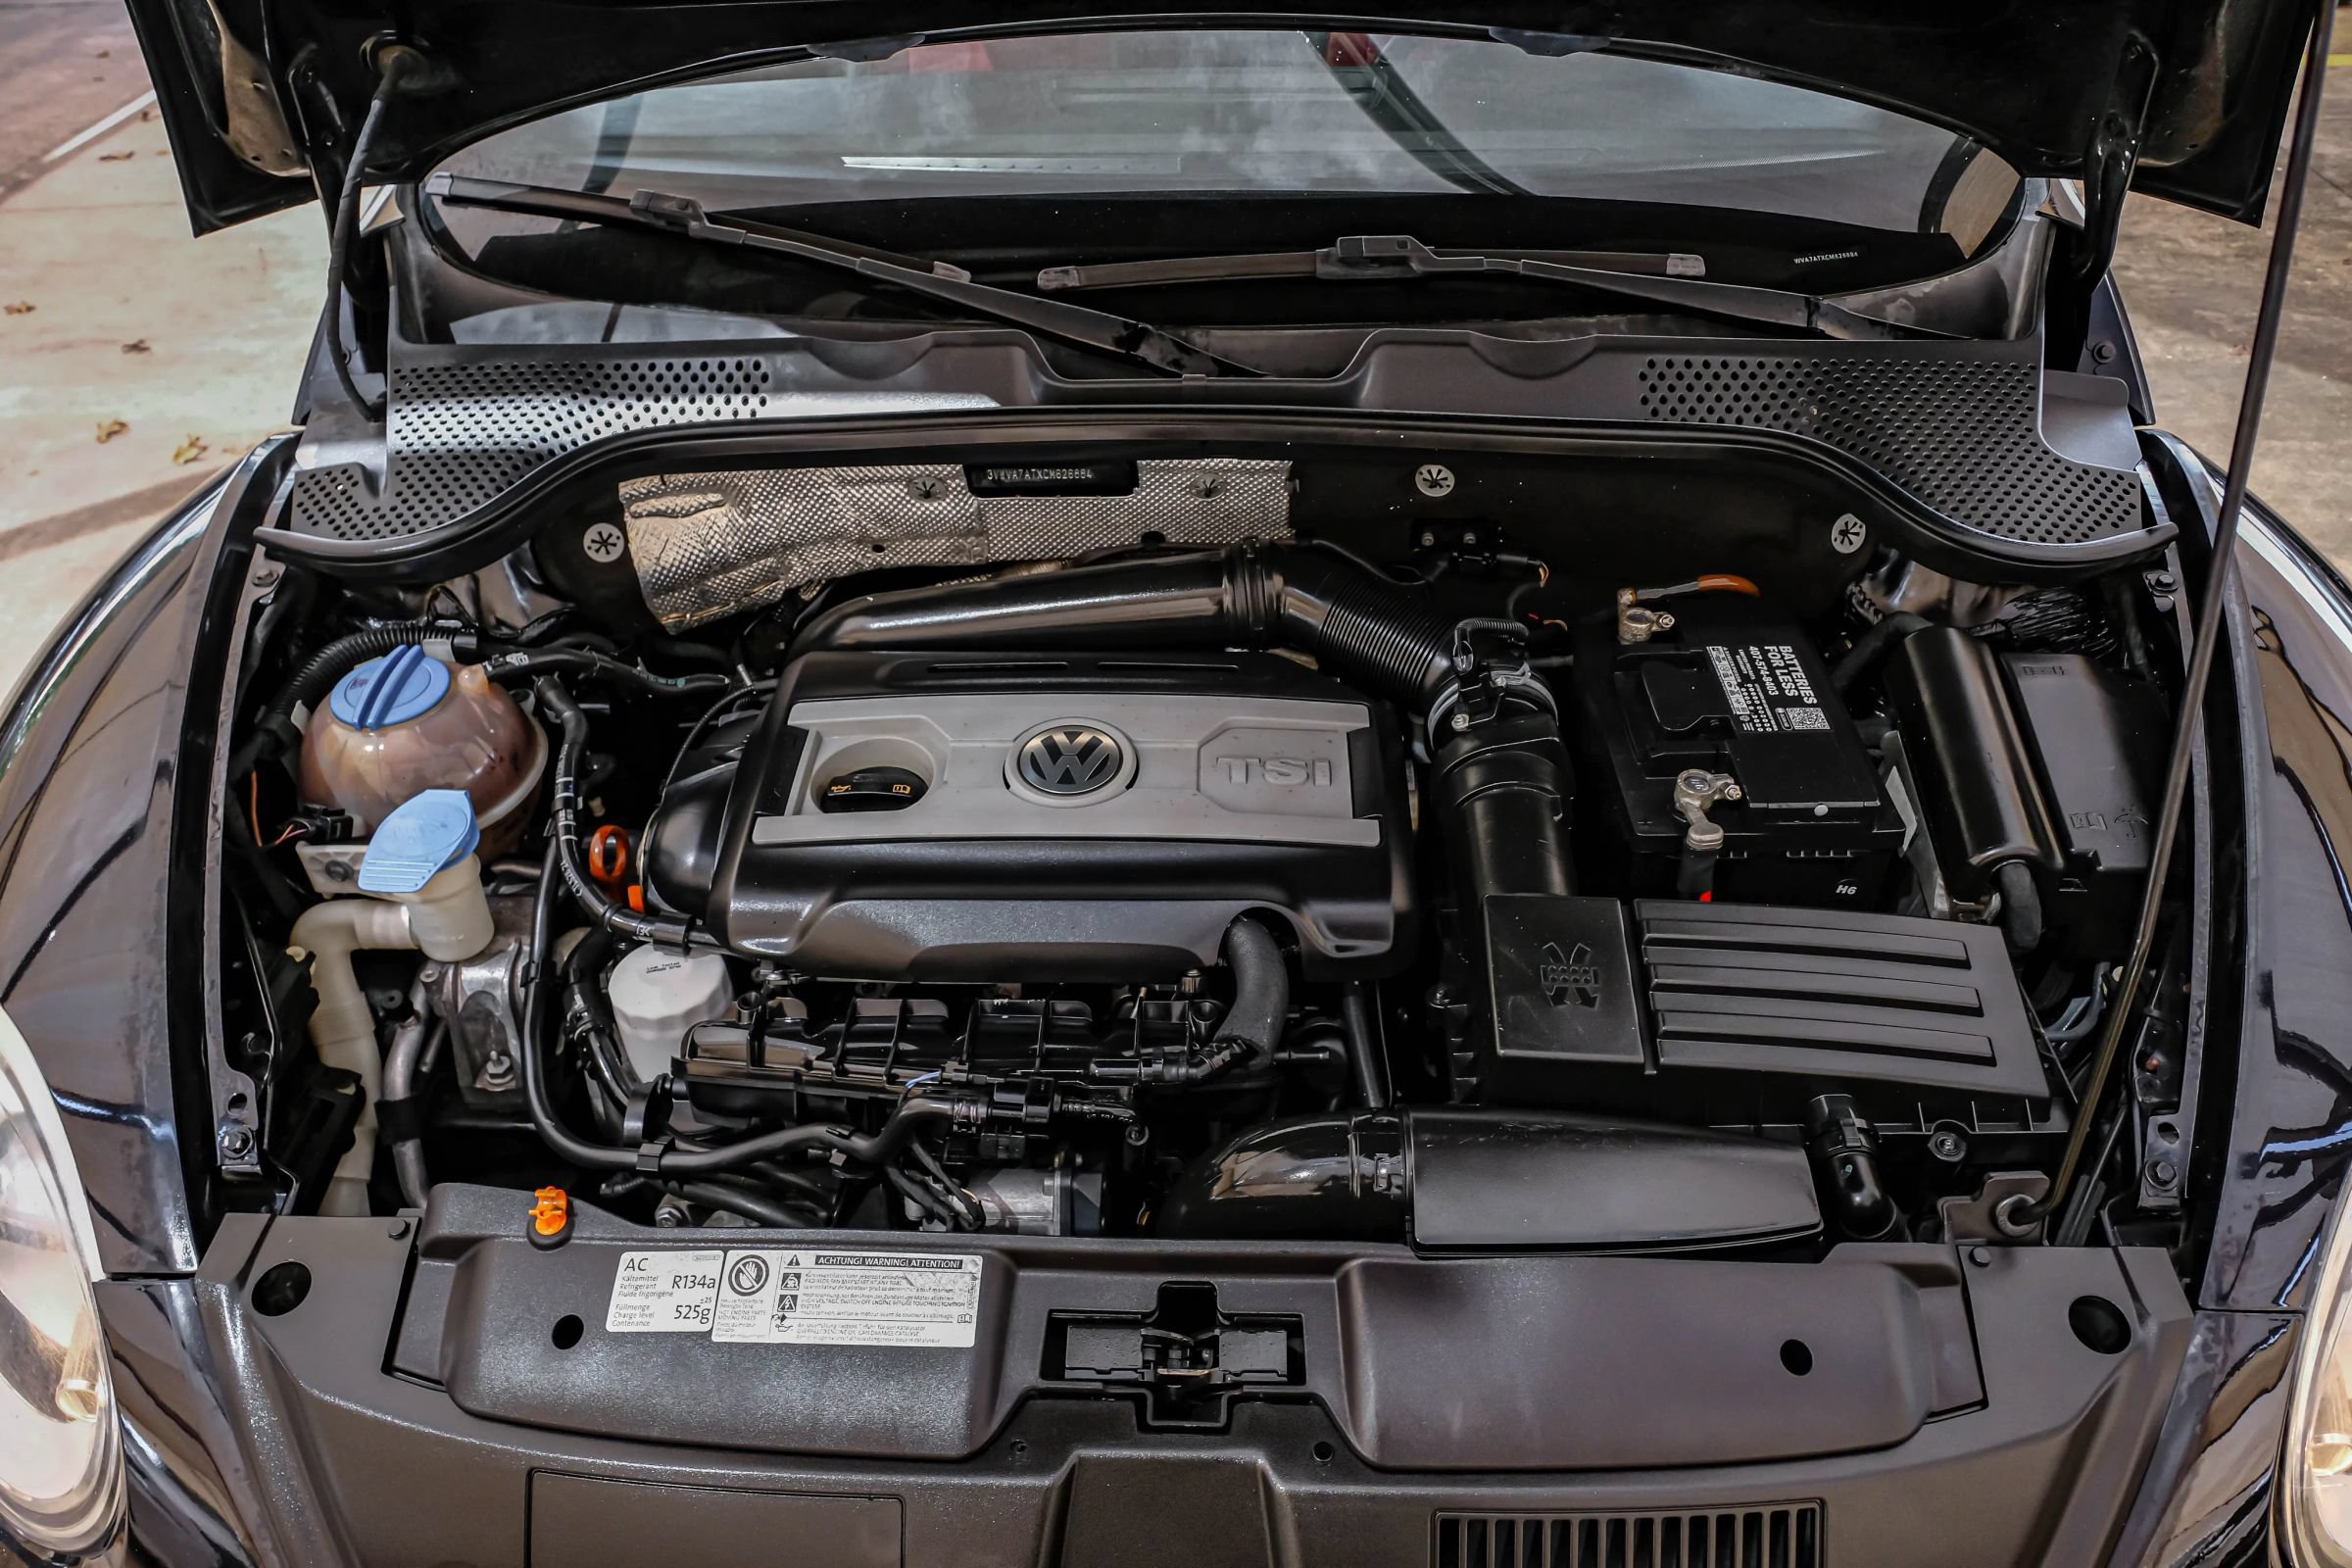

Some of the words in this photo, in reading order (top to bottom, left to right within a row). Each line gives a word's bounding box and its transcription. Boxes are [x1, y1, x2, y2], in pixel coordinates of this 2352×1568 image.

[1749, 646, 1779, 696] 407-574-8403
[1764, 646, 1785, 667] FOR
[1775, 668, 1799, 697] LESS
[1779, 646, 1817, 705] BATTERIES
[1215, 757, 1334, 787] TSI
[1836, 884, 1857, 895] H6
[624, 1258, 649, 1271] AC
[818, 1256, 862, 1265] ACHTUNG!
[864, 1257, 908, 1267] WARNING!
[910, 1259, 959, 1268] ATTENTION!
[672, 1275, 715, 1289] R134a
[674, 1305, 710, 1324] 525g
